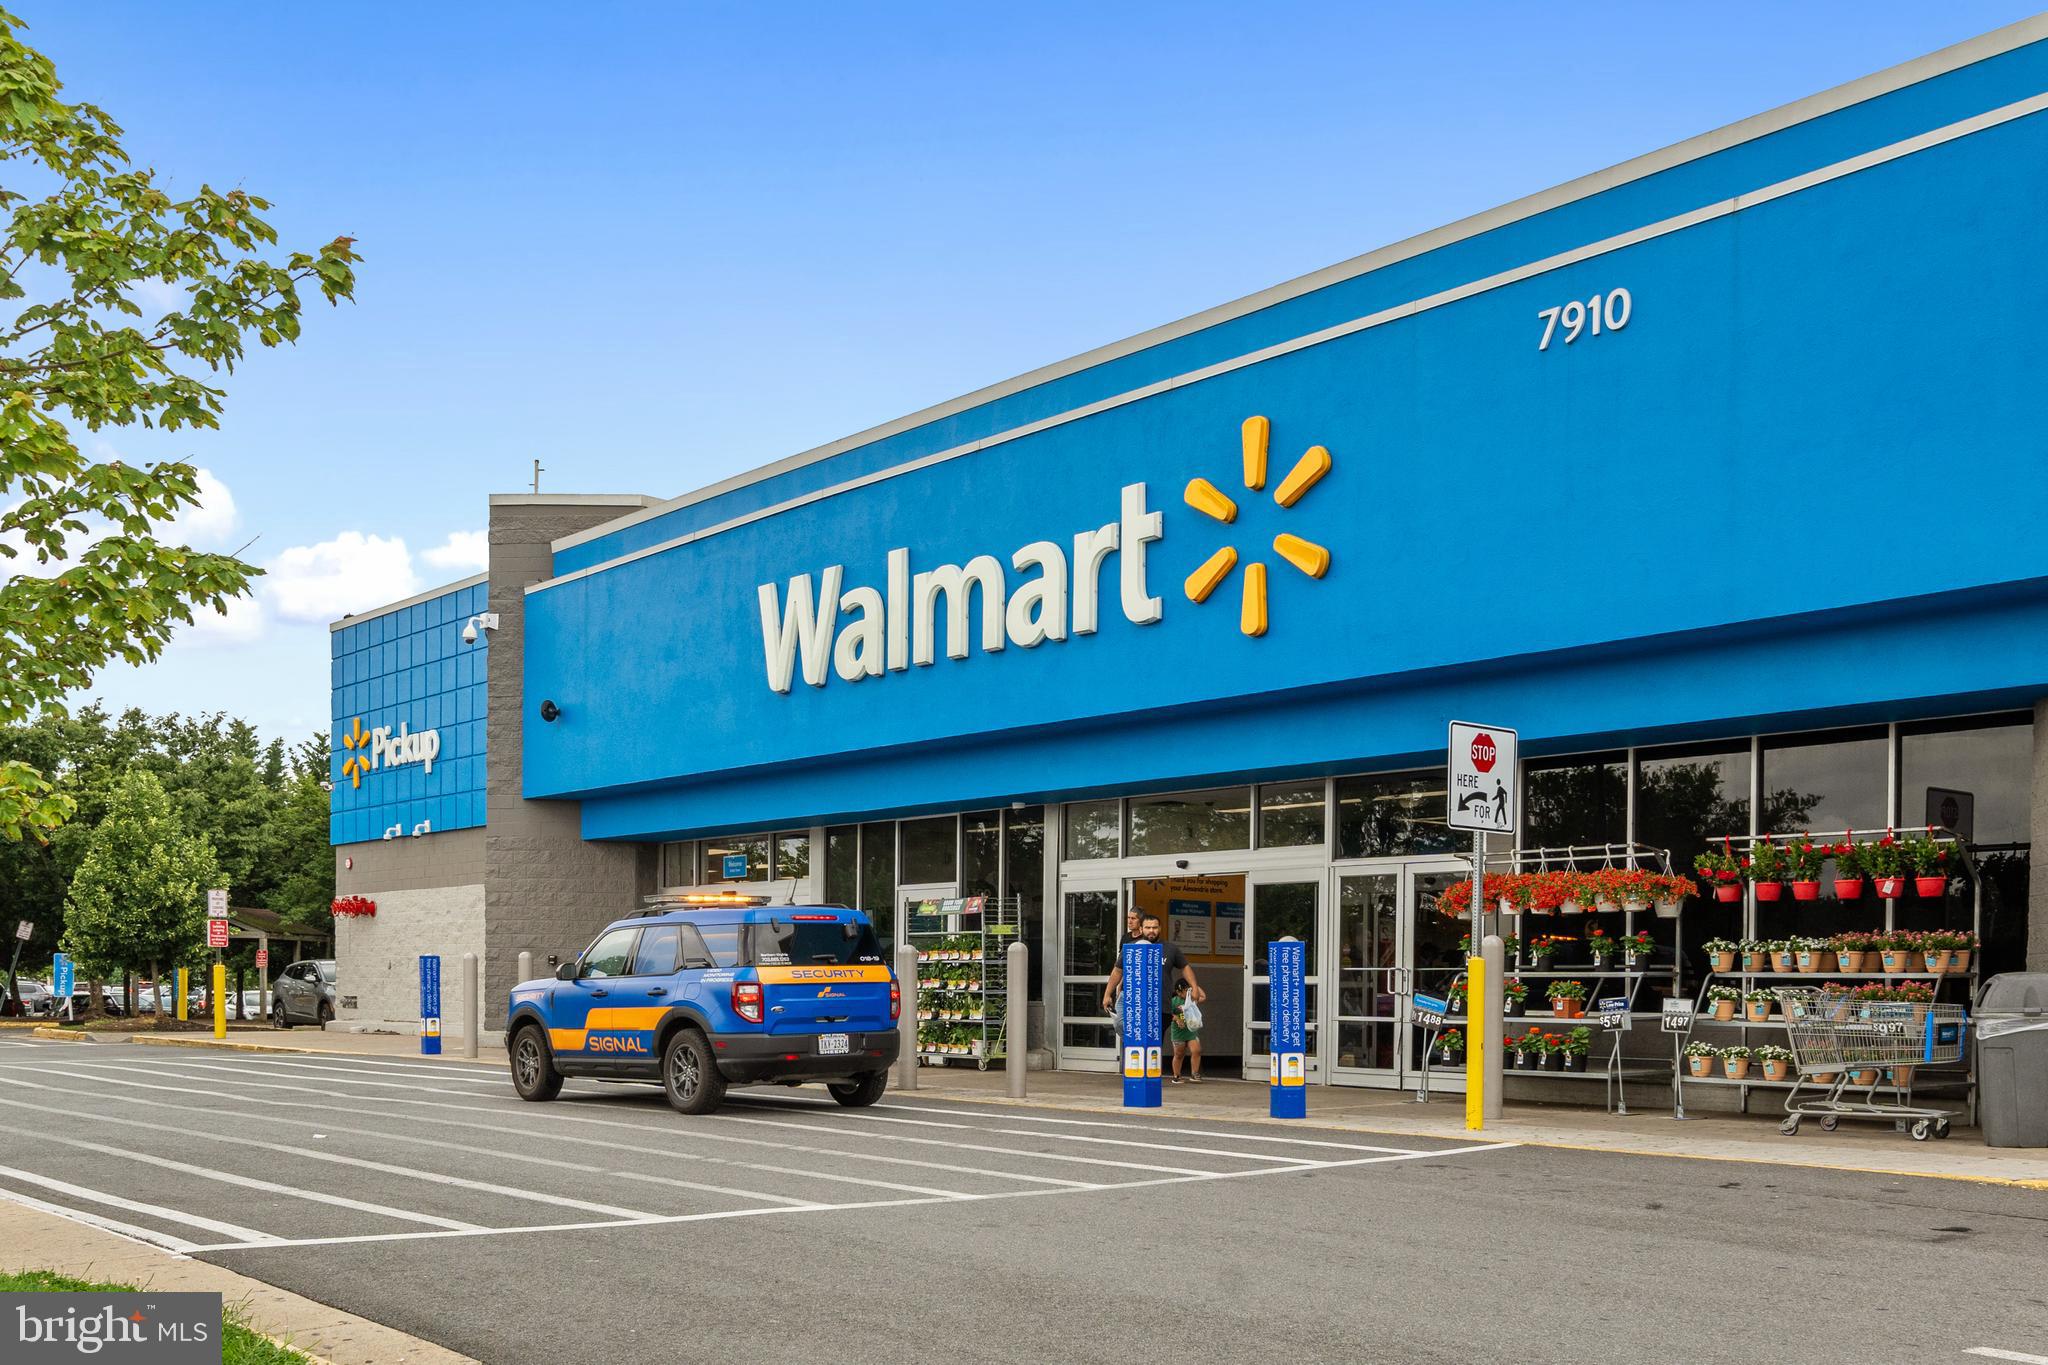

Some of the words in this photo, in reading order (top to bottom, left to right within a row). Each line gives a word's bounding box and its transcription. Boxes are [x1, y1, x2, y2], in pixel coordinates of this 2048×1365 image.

[1538, 287, 1632, 351] 7910
[757, 481, 1163, 694] Walmart
[372, 721, 440, 774] Pickup
[1471, 744, 1496, 761] STOP
[1457, 773, 1479, 789] HERE
[1474, 804, 1491, 819] FOR
[1126, 948, 1134, 964] free
[1281, 947, 1290, 964] free
[1292, 946, 1301, 987] Walmart+
[57, 966, 68, 996] Pickup
[791, 969, 865, 979] SECURITY
[1126, 965, 1134, 1005] pharmacy
[1281, 965, 1290, 1008] pharmacy
[1292, 988, 1301, 1030] members
[1126, 1007, 1134, 1038] delivery
[1281, 1009, 1290, 1043] delivery
[588, 1036, 648, 1053] SIGNAL
[1134, 1028, 1142, 1041] get
[1152, 1028, 1160, 1041] get
[1291, 1031, 1301, 1047] get
